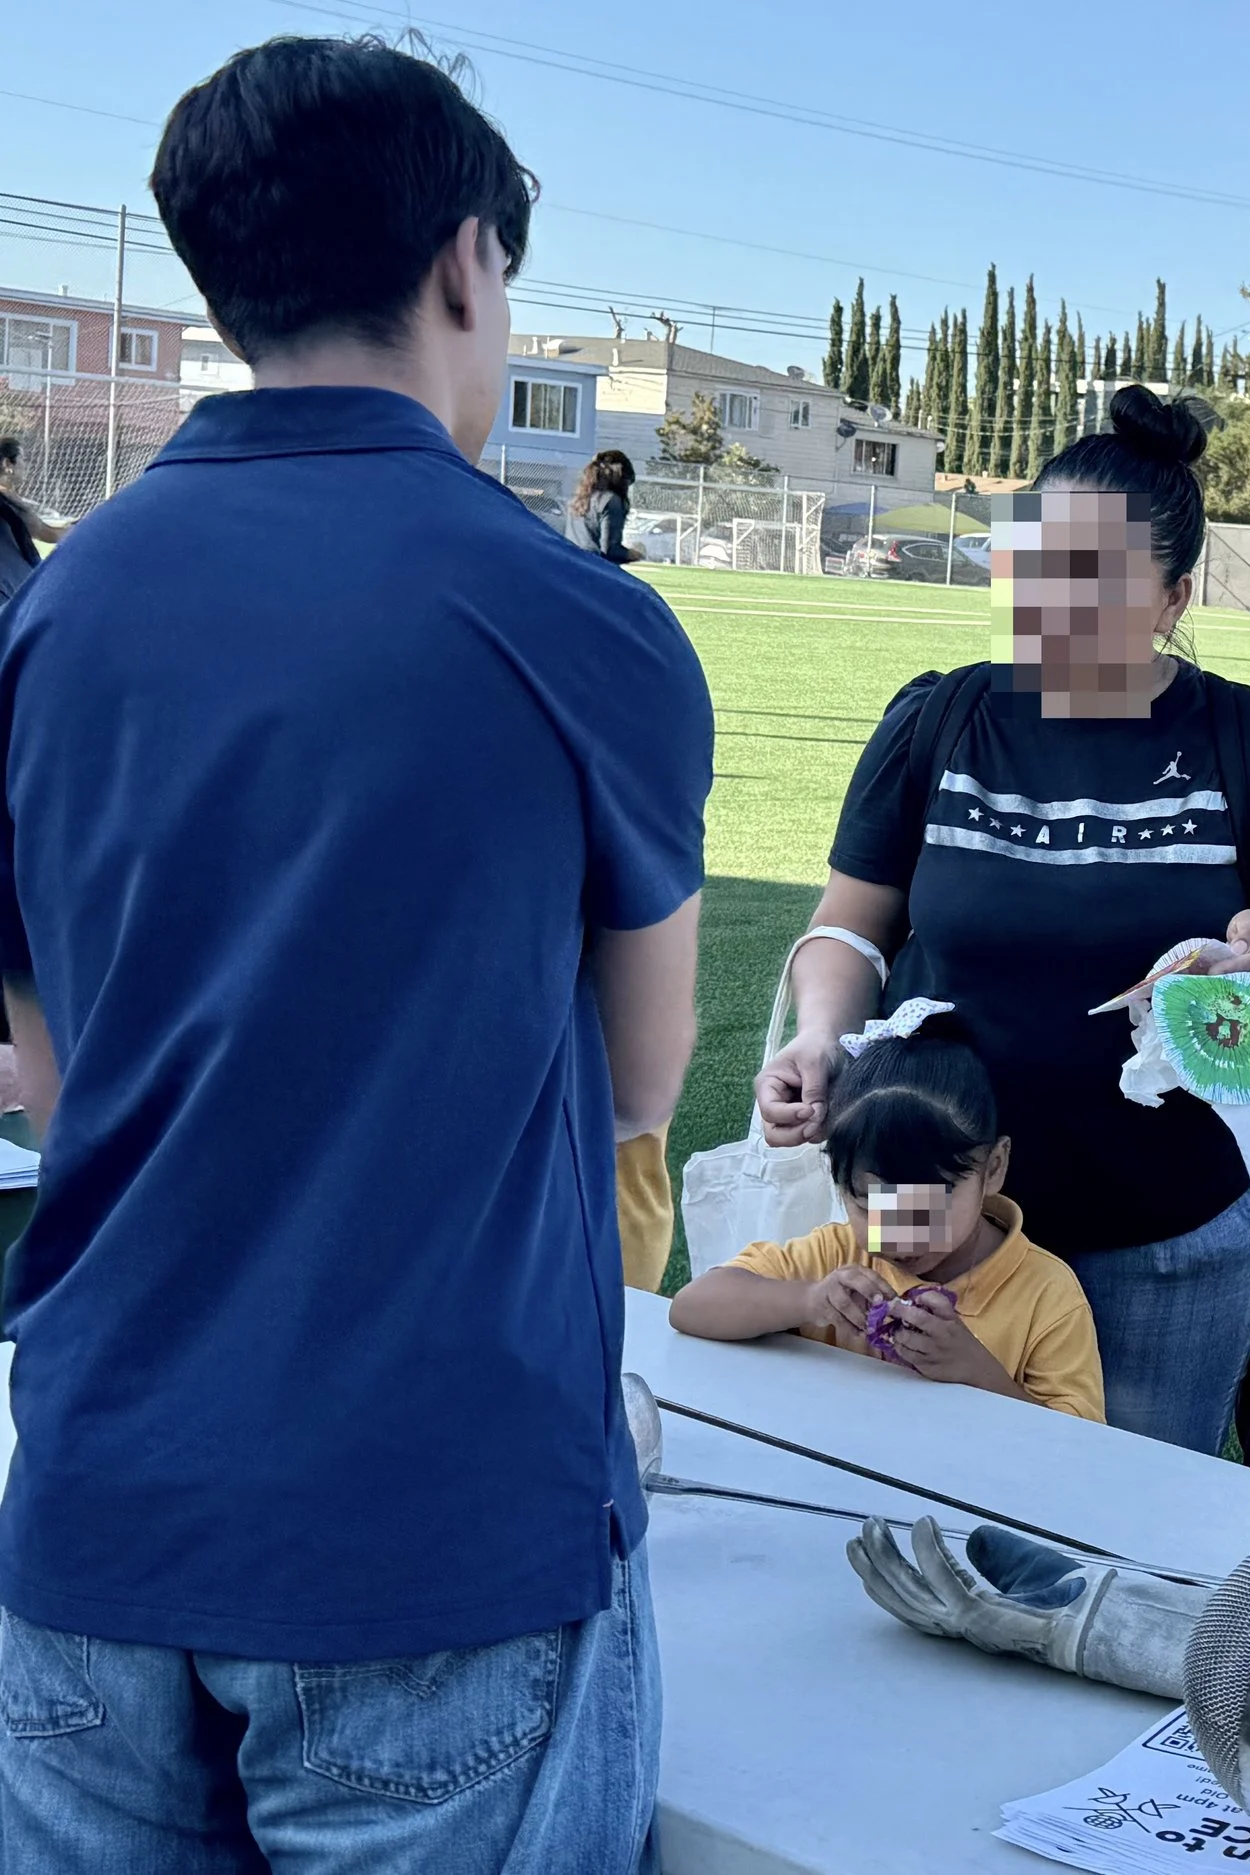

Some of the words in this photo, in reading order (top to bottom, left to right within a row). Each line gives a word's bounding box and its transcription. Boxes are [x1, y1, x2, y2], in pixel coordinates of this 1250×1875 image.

[1036, 823, 1127, 844] AIR
[1200, 1788, 1229, 1799] Old
[1176, 1794, 1218, 1808] 4pm
[1222, 1804, 1243, 1813] at
[1155, 1830, 1206, 1852] to
